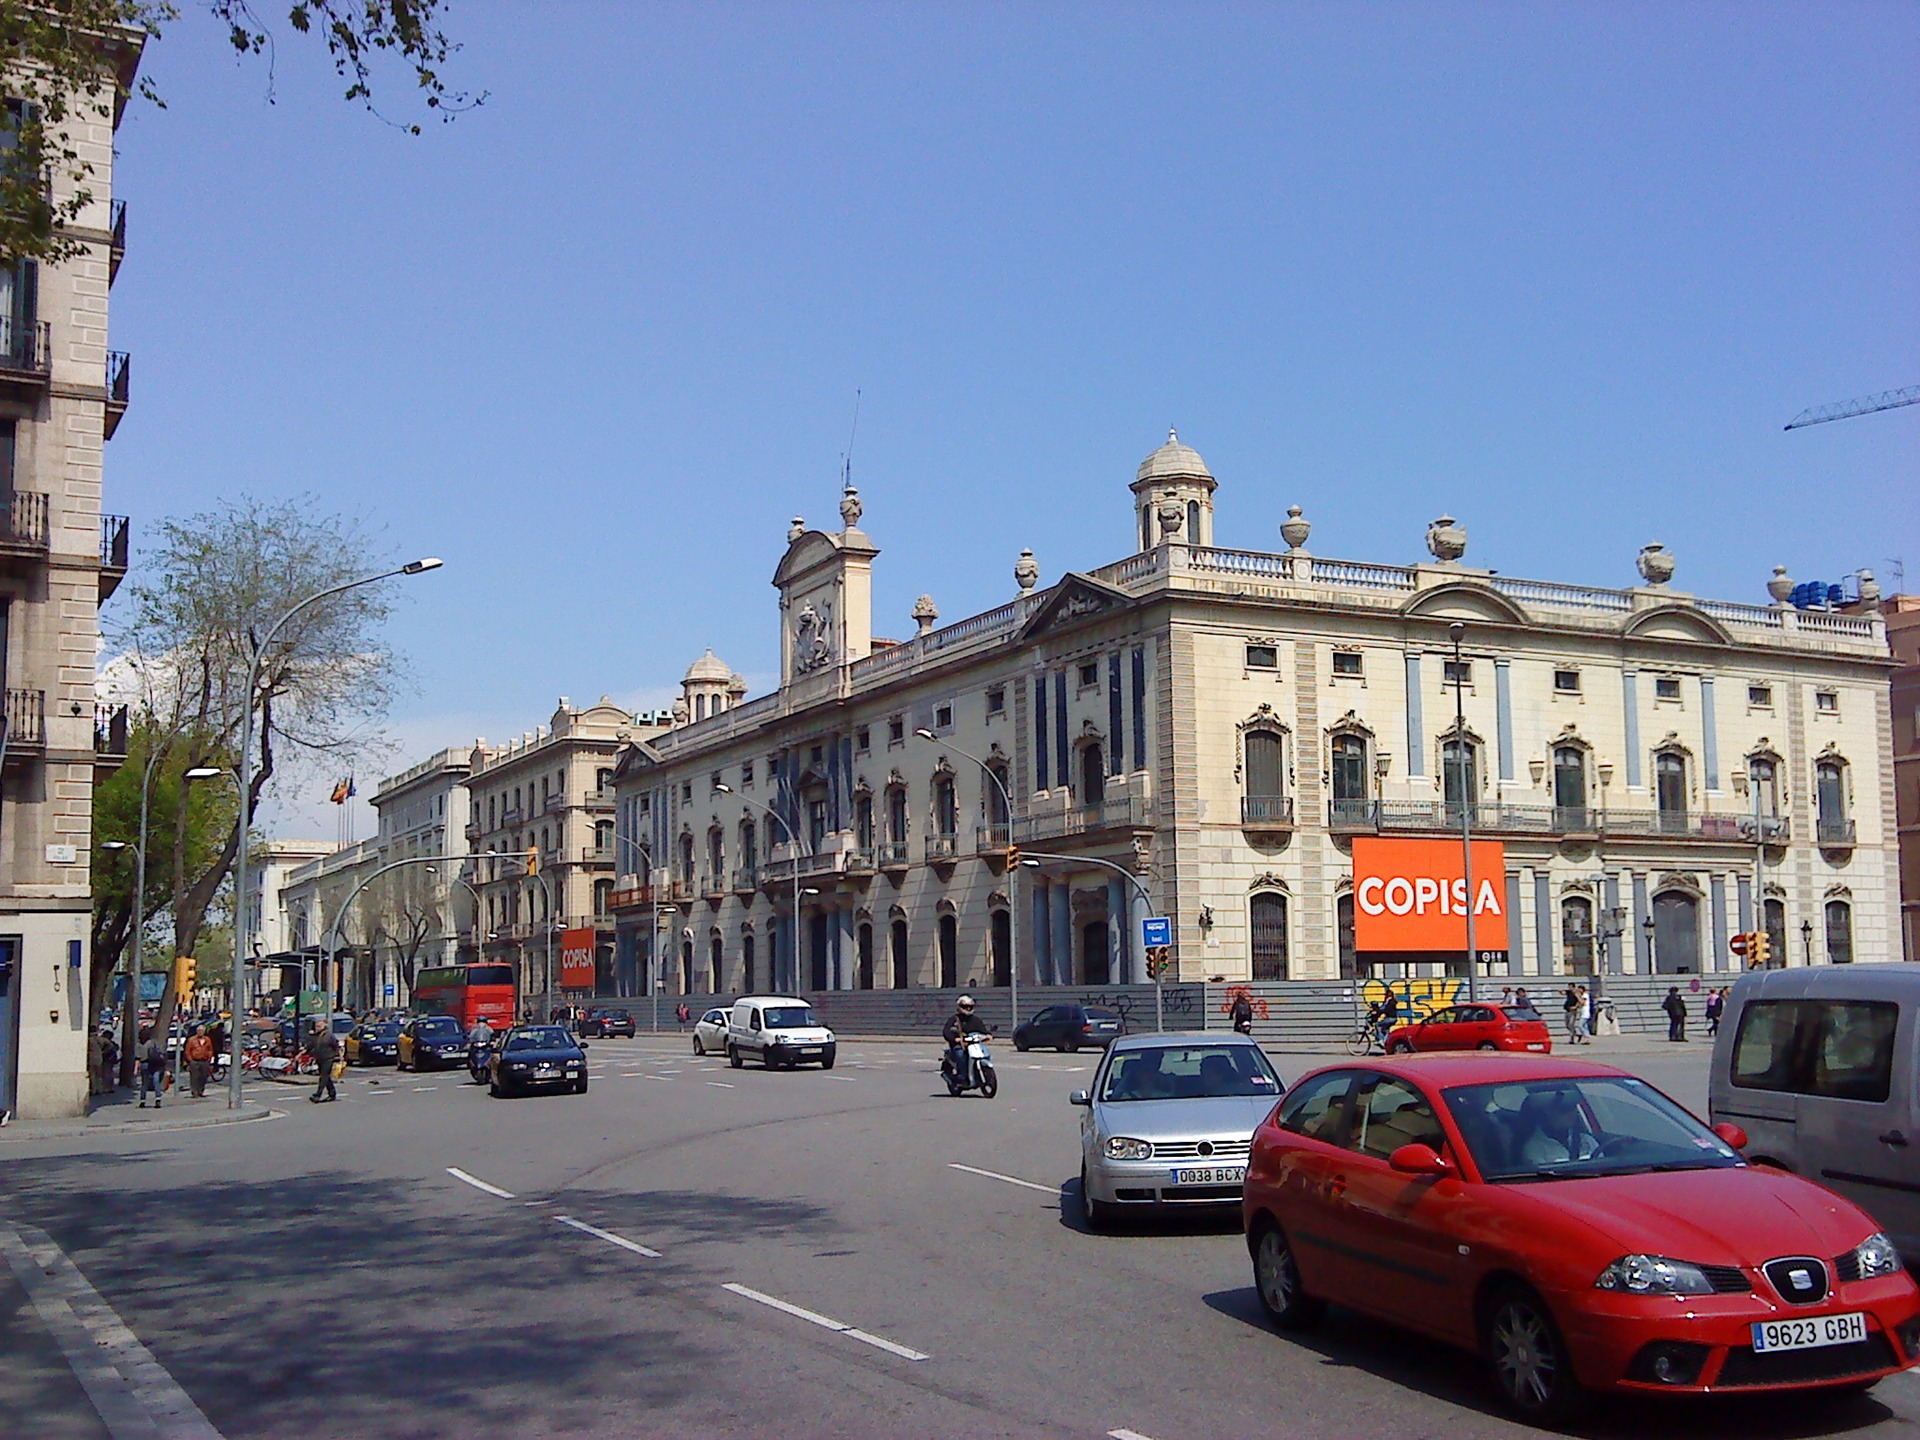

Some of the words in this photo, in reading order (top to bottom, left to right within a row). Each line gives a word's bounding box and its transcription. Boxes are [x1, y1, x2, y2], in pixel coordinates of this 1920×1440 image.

[1358, 877, 1502, 915] COPISA
[562, 947, 593, 969] COPISA
[1216, 1168, 1241, 1181] BCX
[1766, 1322, 1817, 1347] 9623
[1825, 1315, 1862, 1341] GBH
